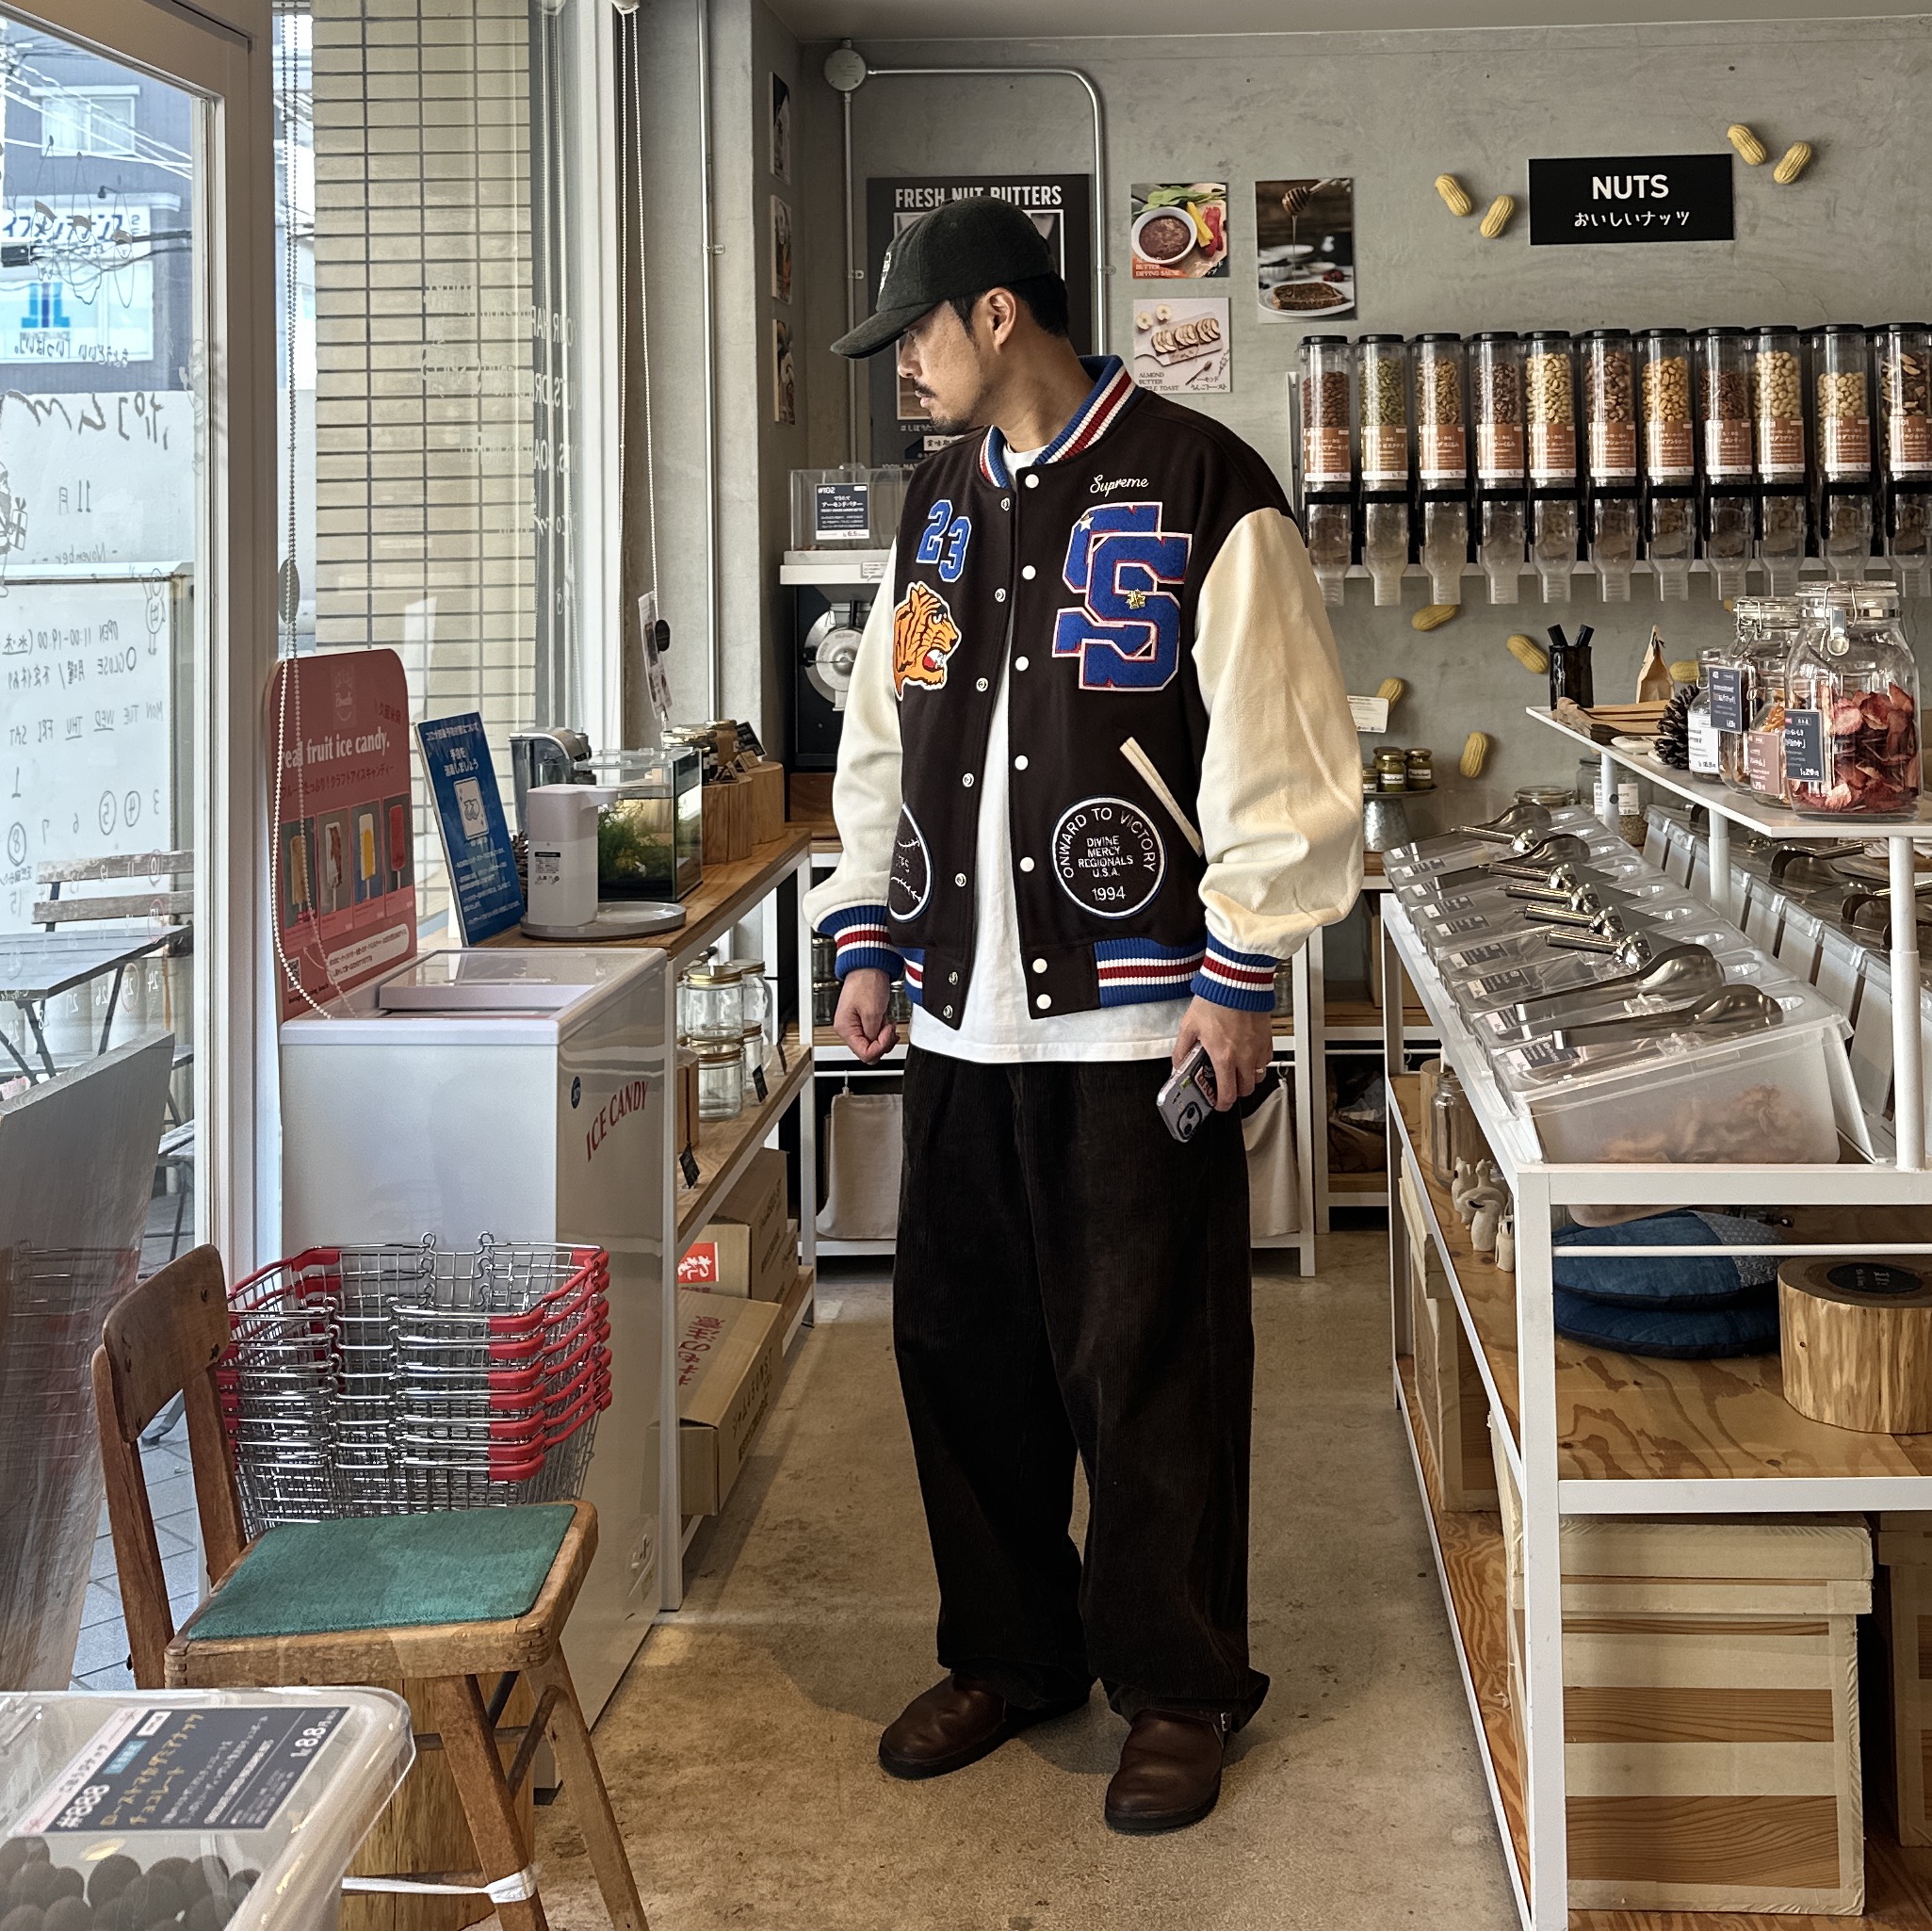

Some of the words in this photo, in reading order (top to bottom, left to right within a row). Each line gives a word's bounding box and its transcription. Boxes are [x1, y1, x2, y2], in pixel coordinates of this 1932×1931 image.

[895, 187, 946, 208] FRESH
[990, 186, 1063, 206] BUTTERS
[1592, 173, 1669, 201] NUTS
[1574, 209, 1690, 228] おいしいナッツ
[1090, 474, 1150, 498] Supreme
[915, 498, 973, 584] 23
[307, 735, 334, 765] fruit
[336, 733, 353, 759] ice
[355, 725, 390, 756] candy.
[1058, 813, 1087, 879] ONWARD
[1091, 806, 1112, 822] TO
[1120, 809, 1157, 873] VICTORY
[1086, 835, 1120, 848] DIVINE
[1087, 846, 1120, 858] MERCY
[1078, 854, 1134, 868] REGIONALS
[1092, 885, 1127, 901] 1994
[586, 1105, 608, 1162] ICE
[609, 1080, 649, 1128] CANDY
[99, 1713, 204, 1826] ローストマカダミアナッツ
[55, 1783, 111, 1829] #888
[128, 1765, 186, 1826] チョコレート
